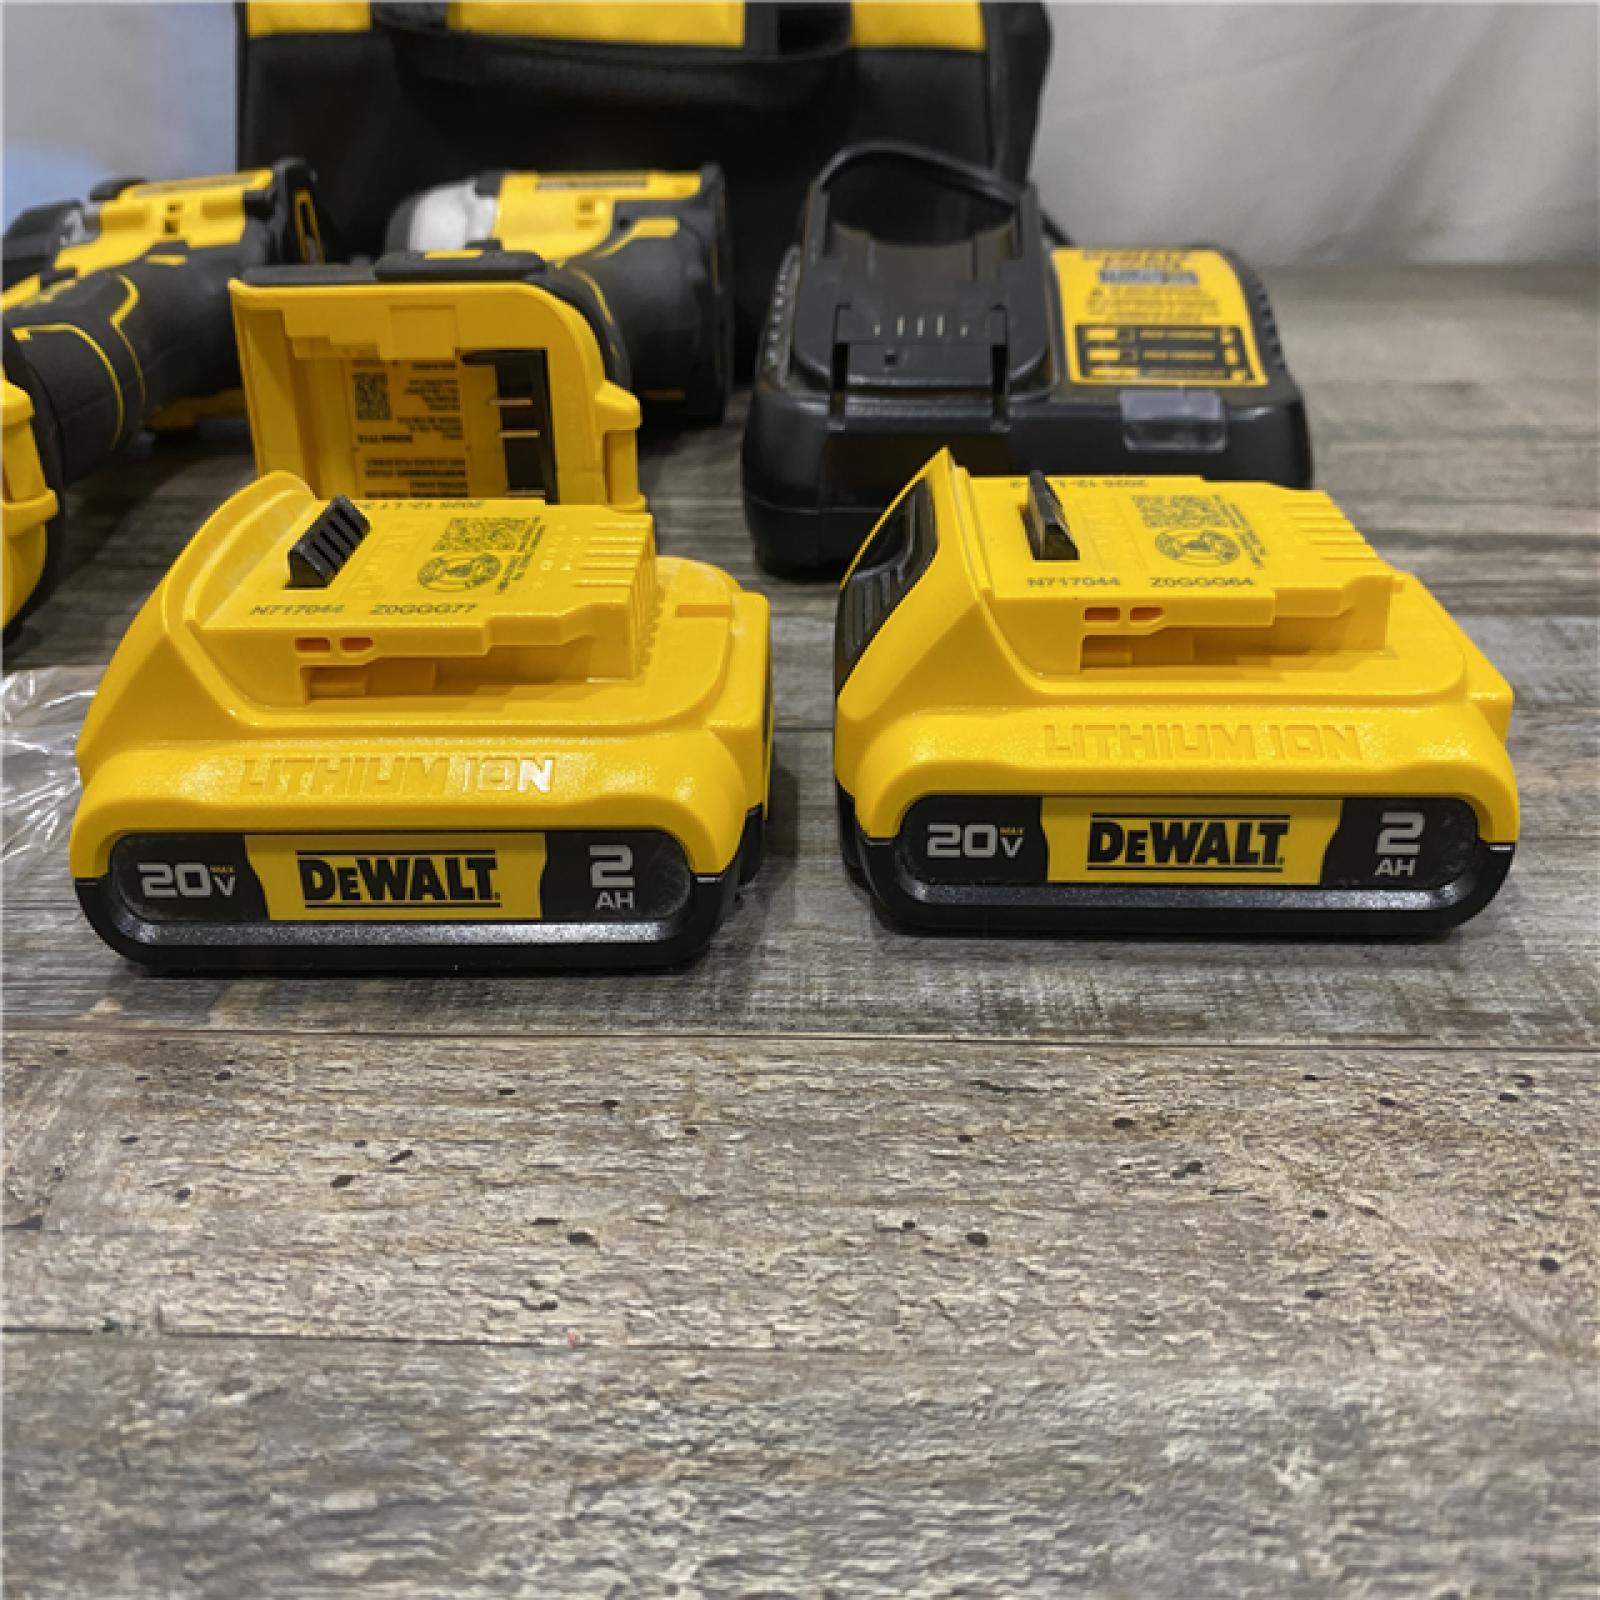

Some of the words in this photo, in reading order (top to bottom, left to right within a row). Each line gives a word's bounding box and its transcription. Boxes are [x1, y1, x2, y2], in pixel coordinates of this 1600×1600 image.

[1042, 724, 1256, 760] LITHIUM
[1268, 724, 1363, 760] ION
[239, 757, 452, 796] LITHIUM
[461, 757, 556, 794] ION
[1376, 812, 1425, 856] 2
[589, 844, 635, 889] 2
[1374, 857, 1416, 877] AH
[595, 890, 636, 911] AH
